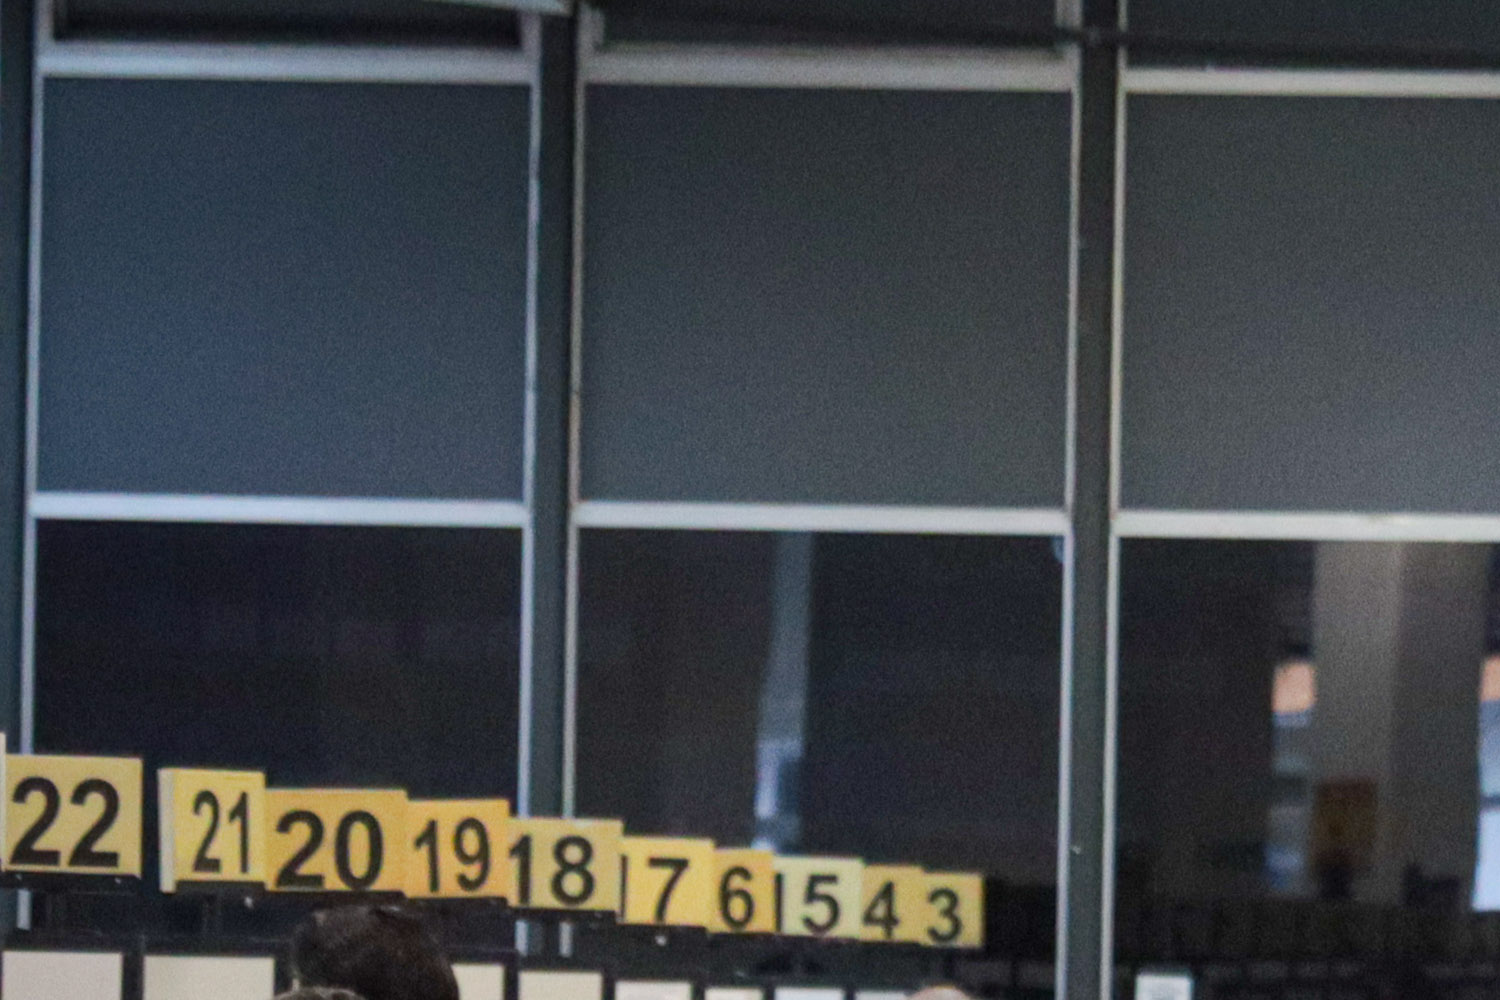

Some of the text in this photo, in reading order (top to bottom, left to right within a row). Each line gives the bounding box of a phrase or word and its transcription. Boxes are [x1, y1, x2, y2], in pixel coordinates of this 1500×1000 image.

[9, 777, 120, 867] 22
[192, 789, 249, 873] 21
[275, 810, 384, 890] 20
[414, 817, 491, 893] 19
[509, 834, 596, 907] 18
[719, 865, 755, 929] 6
[863, 880, 899, 939] 4
[927, 887, 963, 942] 3
